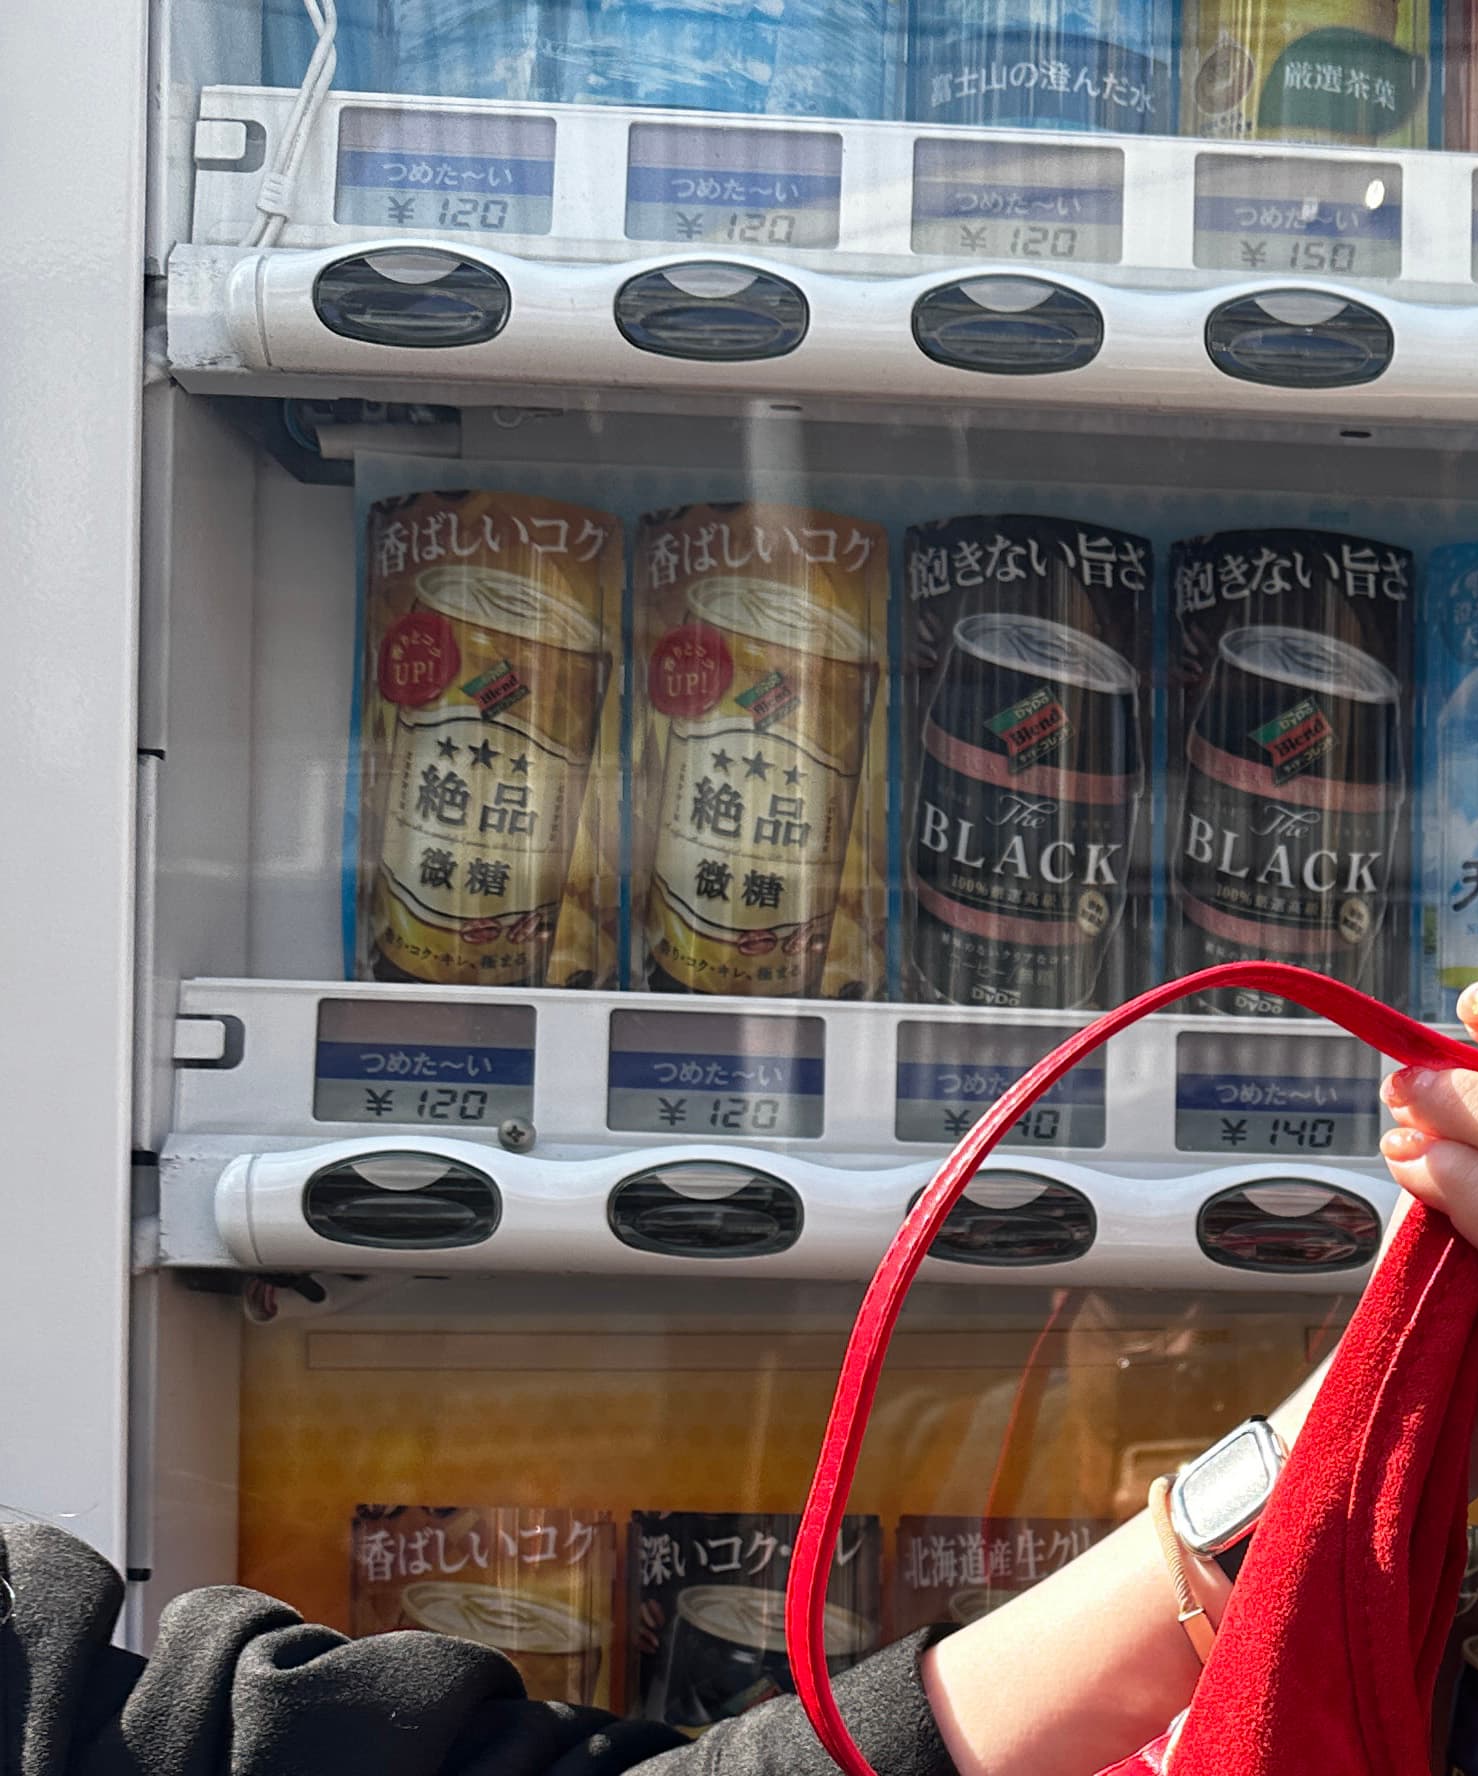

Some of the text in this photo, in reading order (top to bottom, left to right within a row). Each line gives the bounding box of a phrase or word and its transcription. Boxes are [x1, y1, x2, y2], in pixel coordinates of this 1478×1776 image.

[931, 60, 1156, 115] 富士山の澄んだ水
[1283, 62, 1396, 111] 厳選茶葉
[380, 511, 607, 577] 香ばしいコク
[650, 523, 874, 588] 香ばしいコク
[909, 532, 1146, 600] 飽きない旨さ
[1174, 543, 1409, 613] 飽きない旨さ
[415, 764, 539, 837] 絶品
[689, 775, 811, 849] 絶品
[420, 847, 511, 897] 微糖
[920, 802, 1122, 885] BLACK
[1188, 815, 1382, 893] BLACK
[695, 858, 786, 909] 微糖
[363, 1520, 596, 1582] 香ばしいコク
